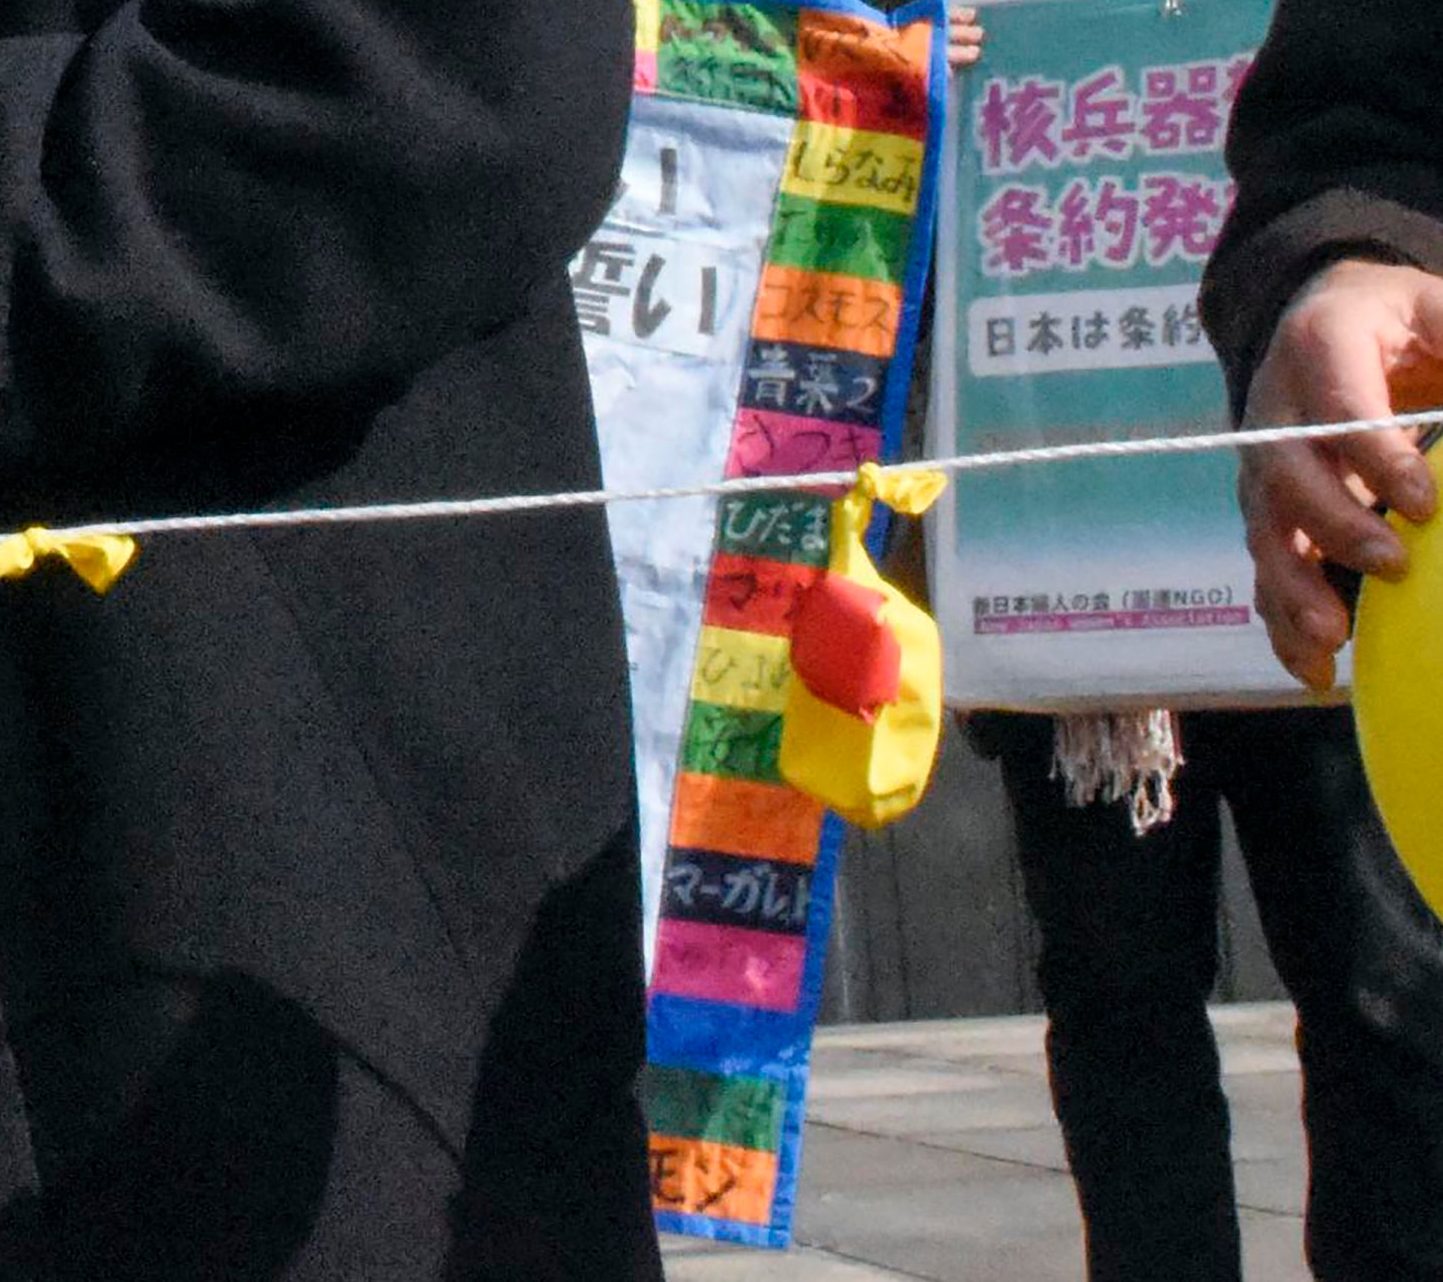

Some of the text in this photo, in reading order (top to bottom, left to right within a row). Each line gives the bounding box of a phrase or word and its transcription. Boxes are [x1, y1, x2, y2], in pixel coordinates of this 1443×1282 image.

[980, 58, 1255, 169] 核兵器
[981, 176, 1238, 272] 条約発
[761, 284, 892, 335] コスモス
